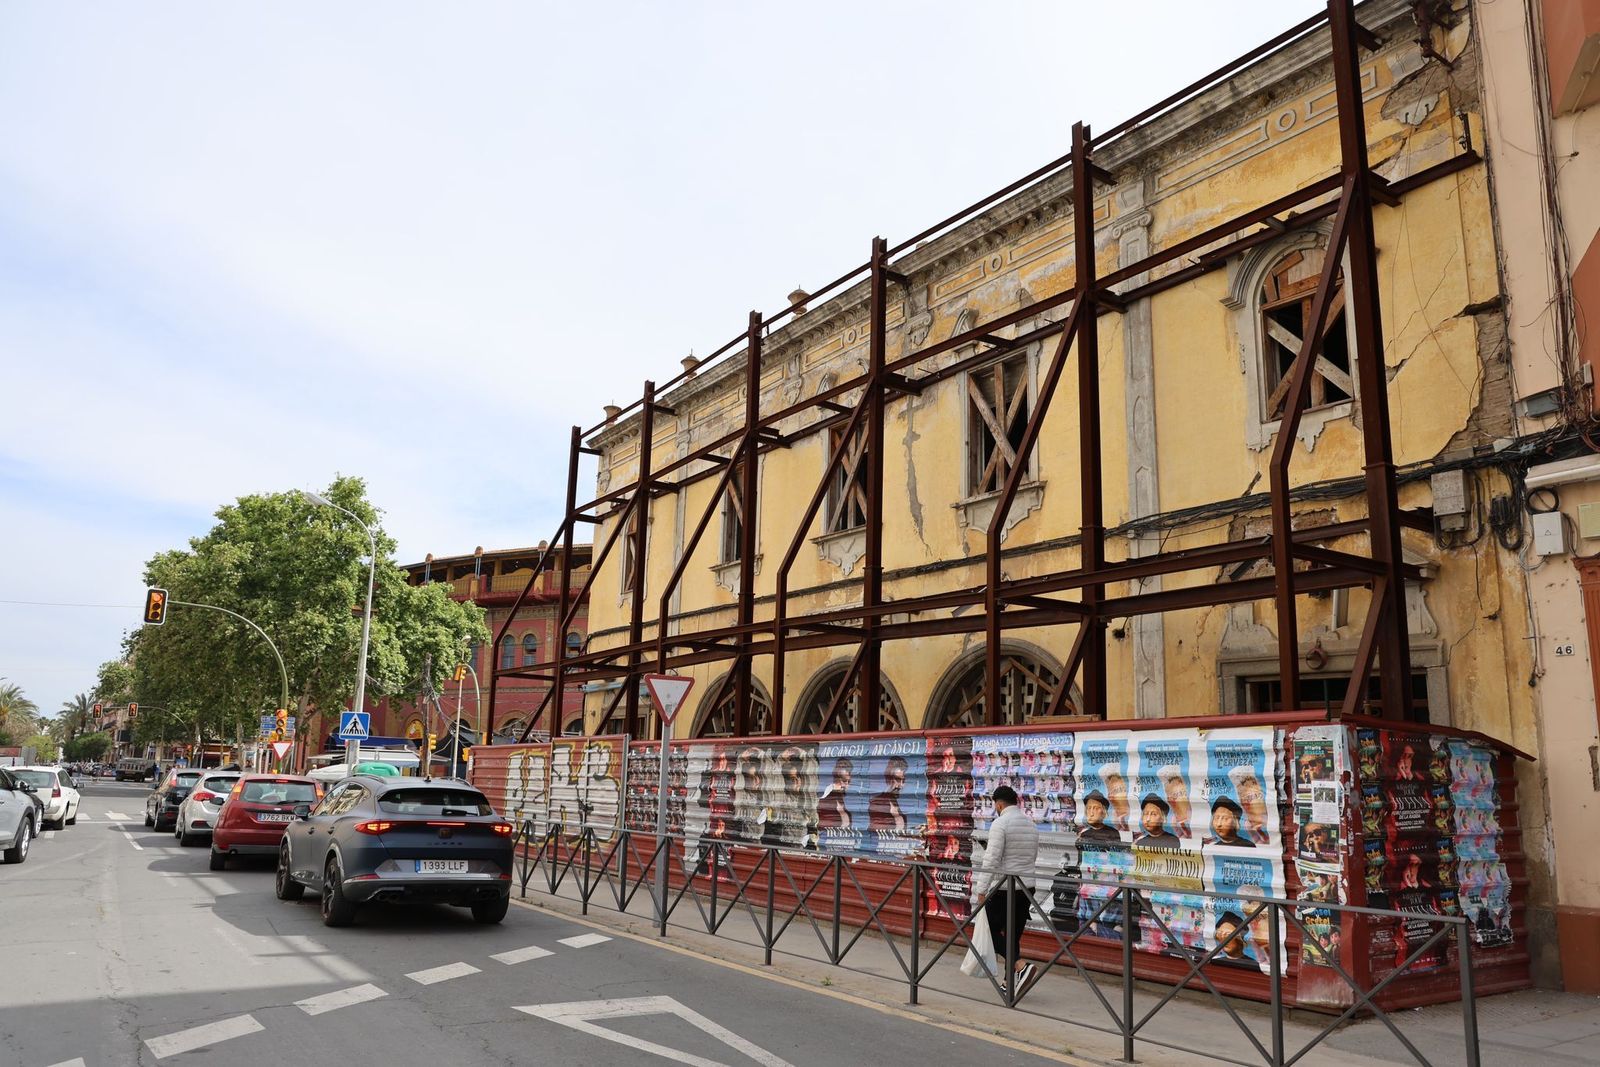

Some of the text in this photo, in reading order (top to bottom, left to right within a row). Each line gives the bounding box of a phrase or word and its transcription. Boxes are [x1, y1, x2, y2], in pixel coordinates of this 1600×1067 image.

[1556, 646, 1572, 654] 46
[1218, 758, 1253, 769] CERVEZA
[424, 862, 464, 870] 1393 LLF
[1135, 856, 1156, 873] DAVID
[1166, 858, 1200, 878] MIRANDA
[1230, 868, 1248, 876] FERIA
